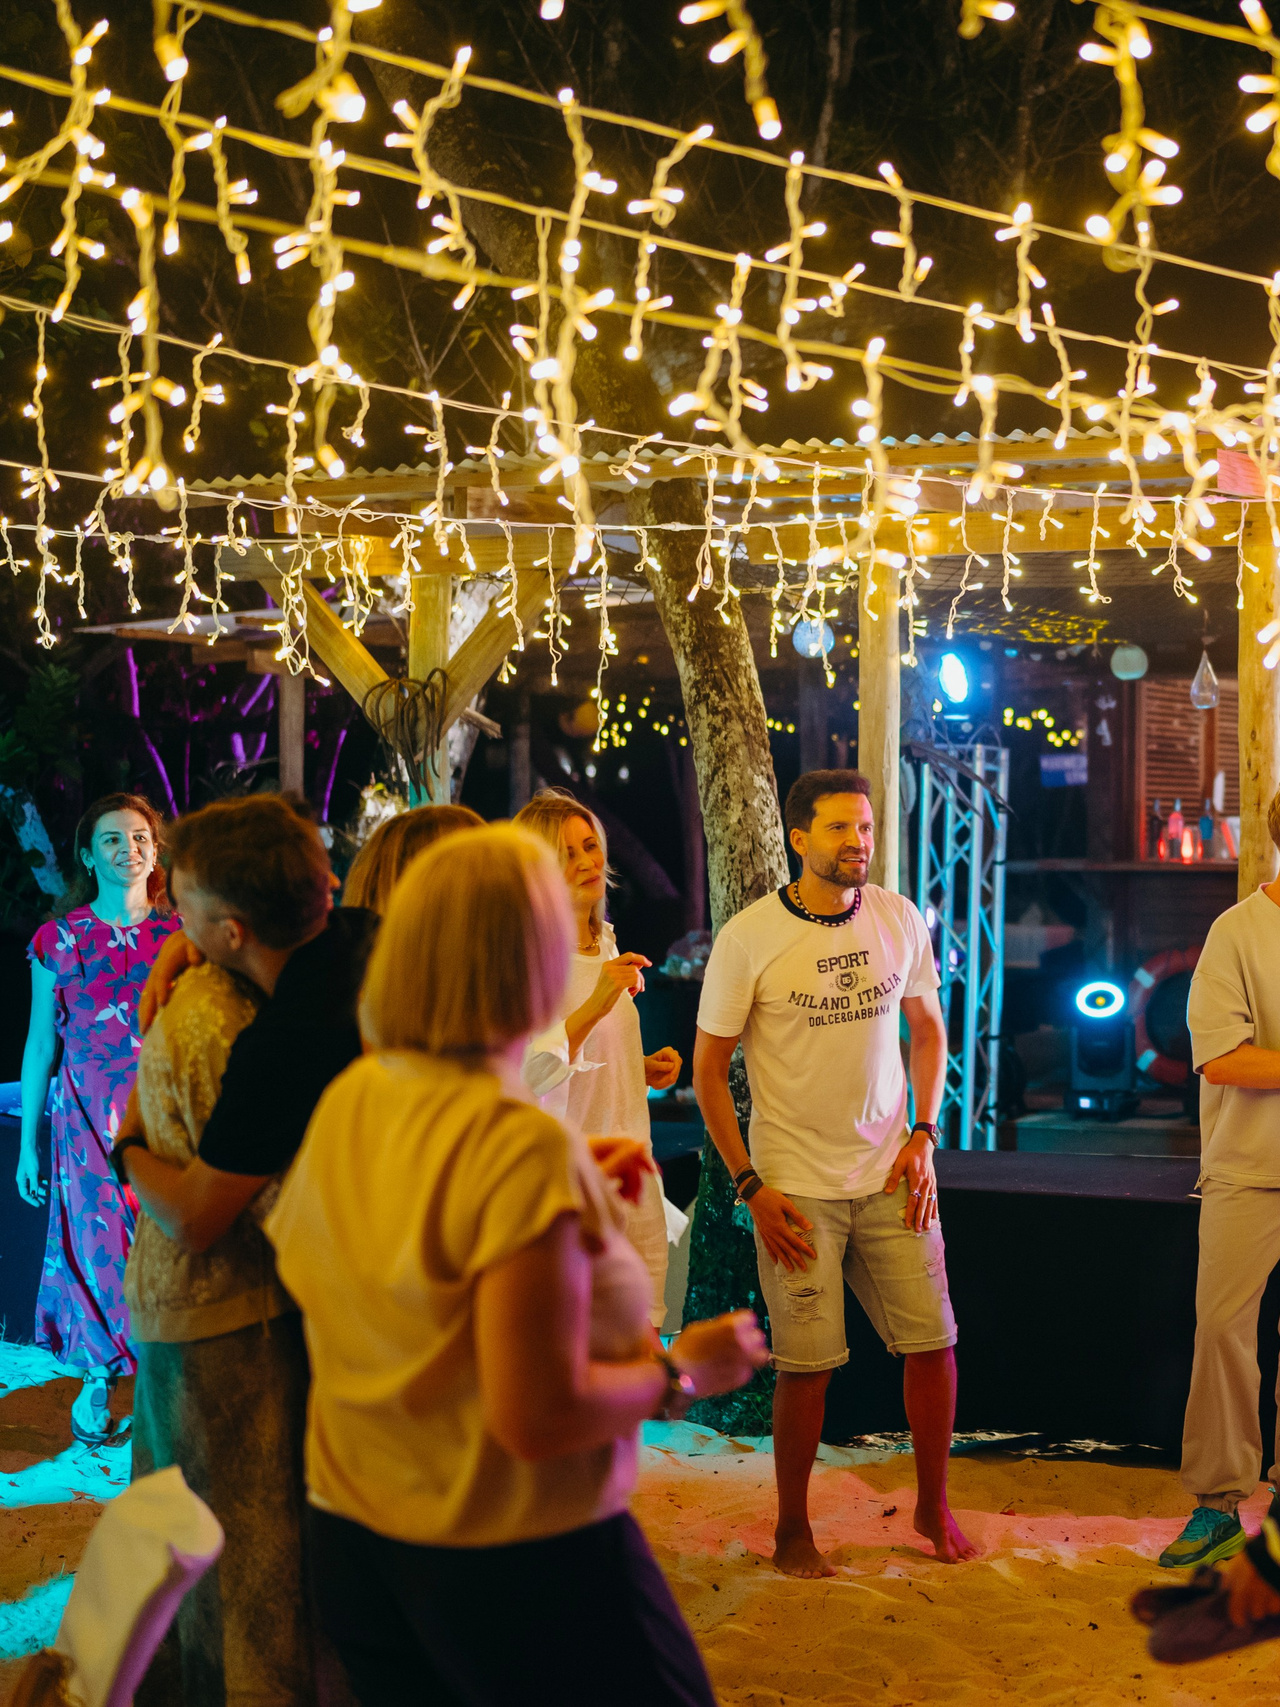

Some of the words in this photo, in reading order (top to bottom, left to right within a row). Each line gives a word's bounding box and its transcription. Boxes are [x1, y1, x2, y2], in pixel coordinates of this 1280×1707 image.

[816, 950, 870, 974] SPORT
[787, 990, 850, 1011] MILANO
[857, 972, 902, 1006] ITALIA
[808, 1004, 890, 1028] DOLCE&GABBANA
